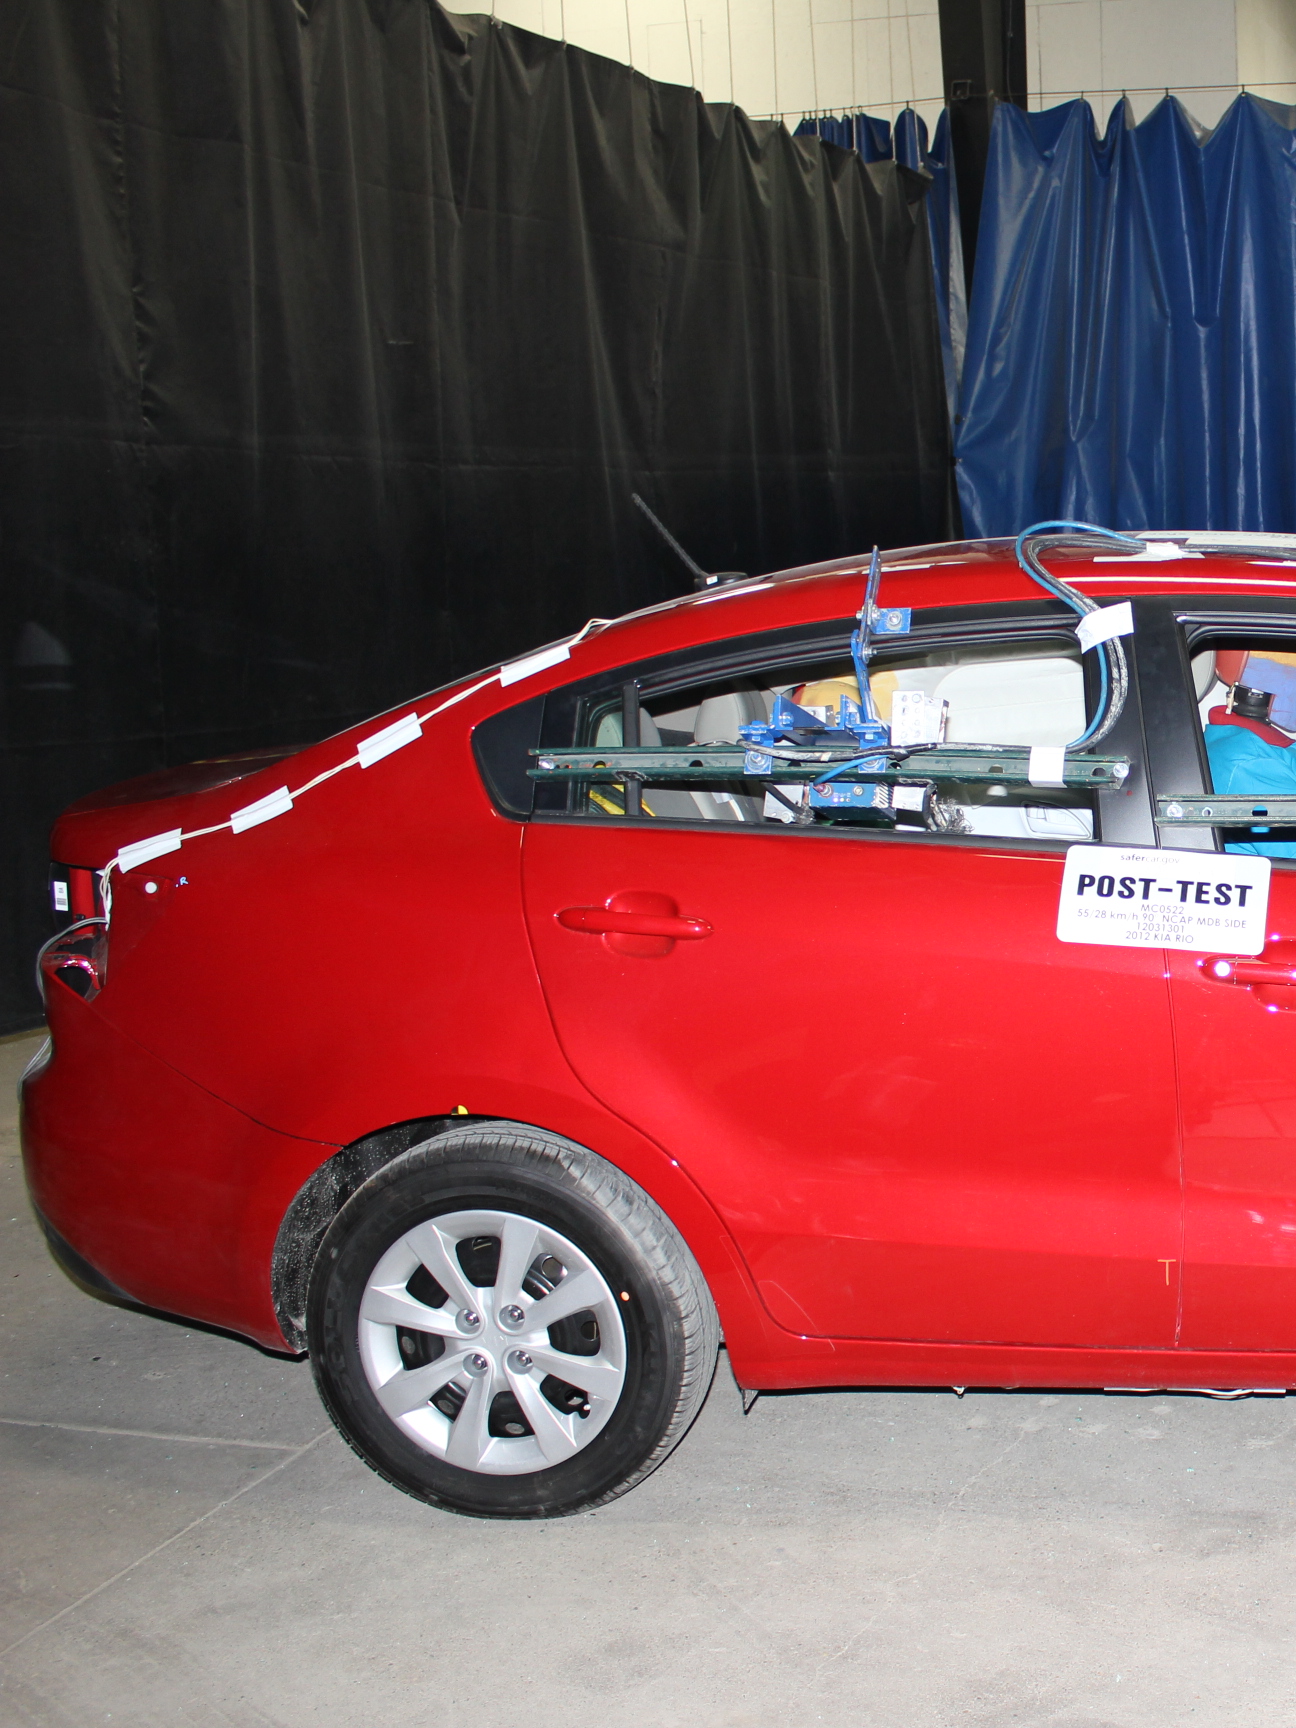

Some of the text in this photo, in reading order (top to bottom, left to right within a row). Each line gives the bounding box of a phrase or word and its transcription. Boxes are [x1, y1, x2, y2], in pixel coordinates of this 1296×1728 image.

[1120, 853, 1181, 865] safercar.gov
[1077, 873, 1254, 907] POST-TEST
[1140, 904, 1185, 915] MC0522
[1077, 908, 1107, 919] 55/28
[1110, 910, 1139, 922] km/h
[1162, 914, 1194, 925] NCAP
[1196, 917, 1221, 927] MDB
[1224, 918, 1248, 929] SIDE
[1137, 922, 1185, 933] 12031301
[1125, 930, 1194, 944] 2012 KIA RIO
